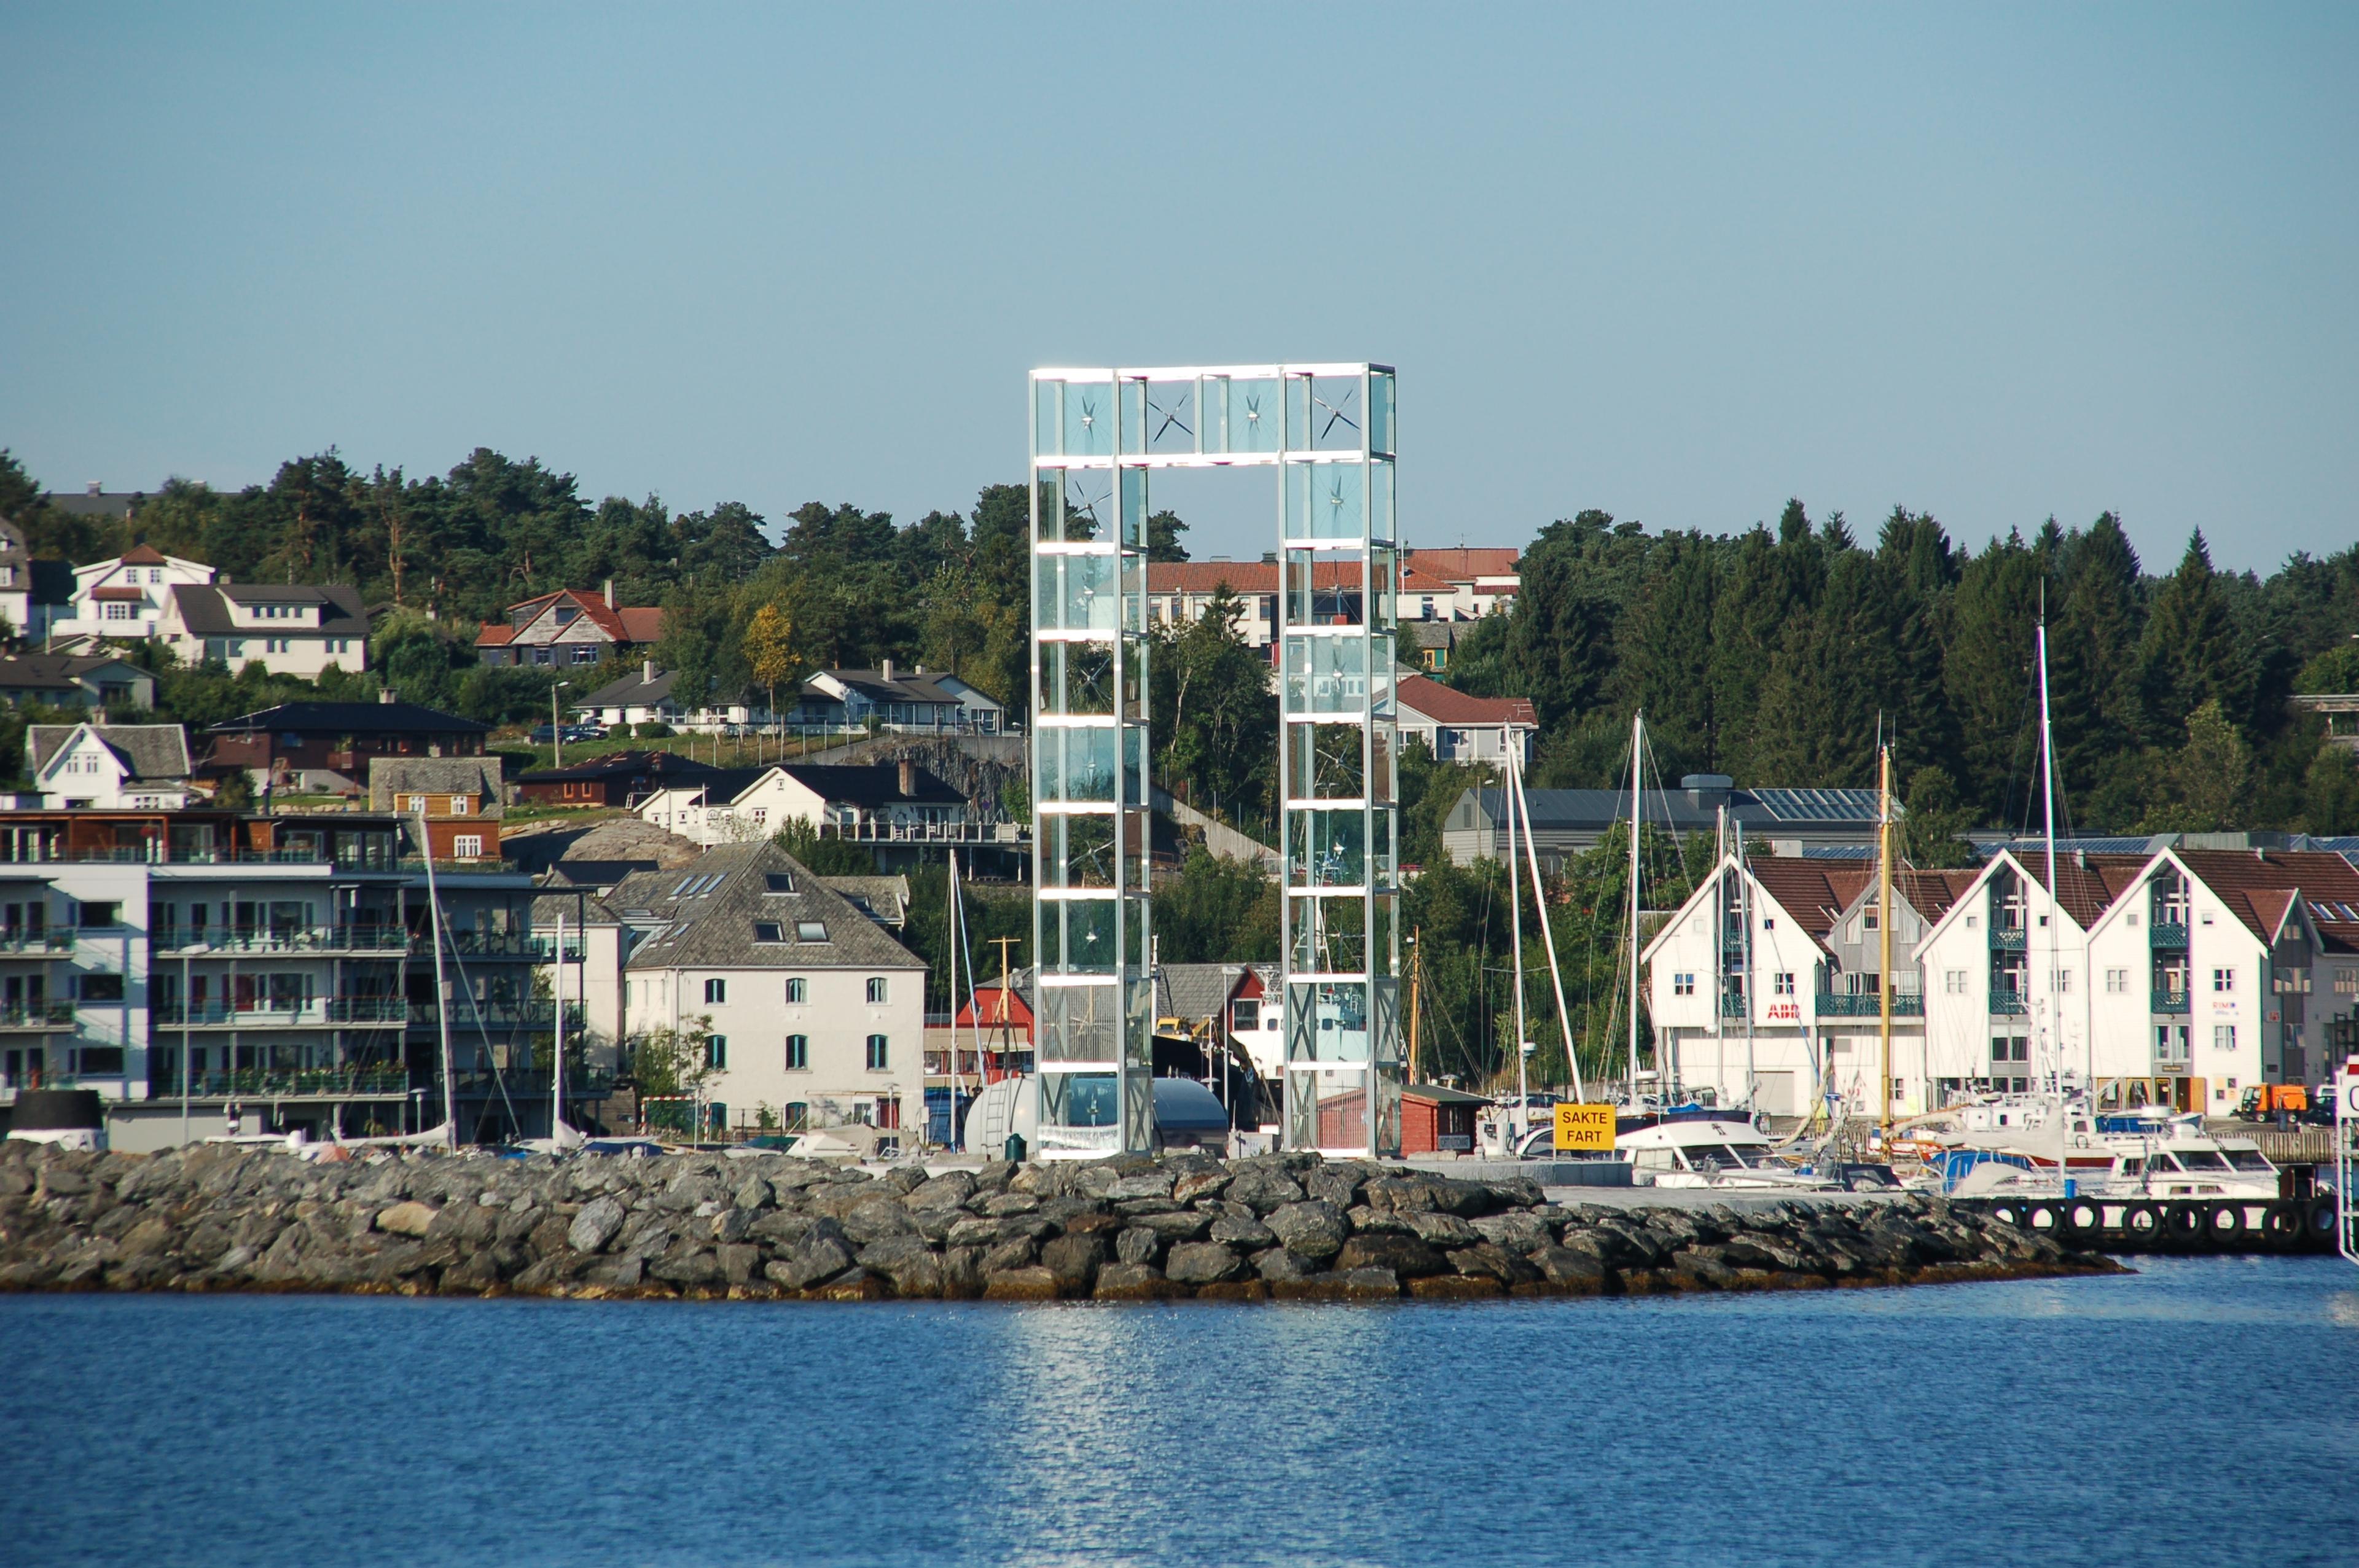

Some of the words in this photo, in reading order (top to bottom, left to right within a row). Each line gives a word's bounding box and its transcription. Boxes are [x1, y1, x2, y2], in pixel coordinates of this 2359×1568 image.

[1768, 1004, 1799, 1018] ABB
[1562, 1111, 1608, 1125] SAKTE
[1567, 1130, 1603, 1142] FART
